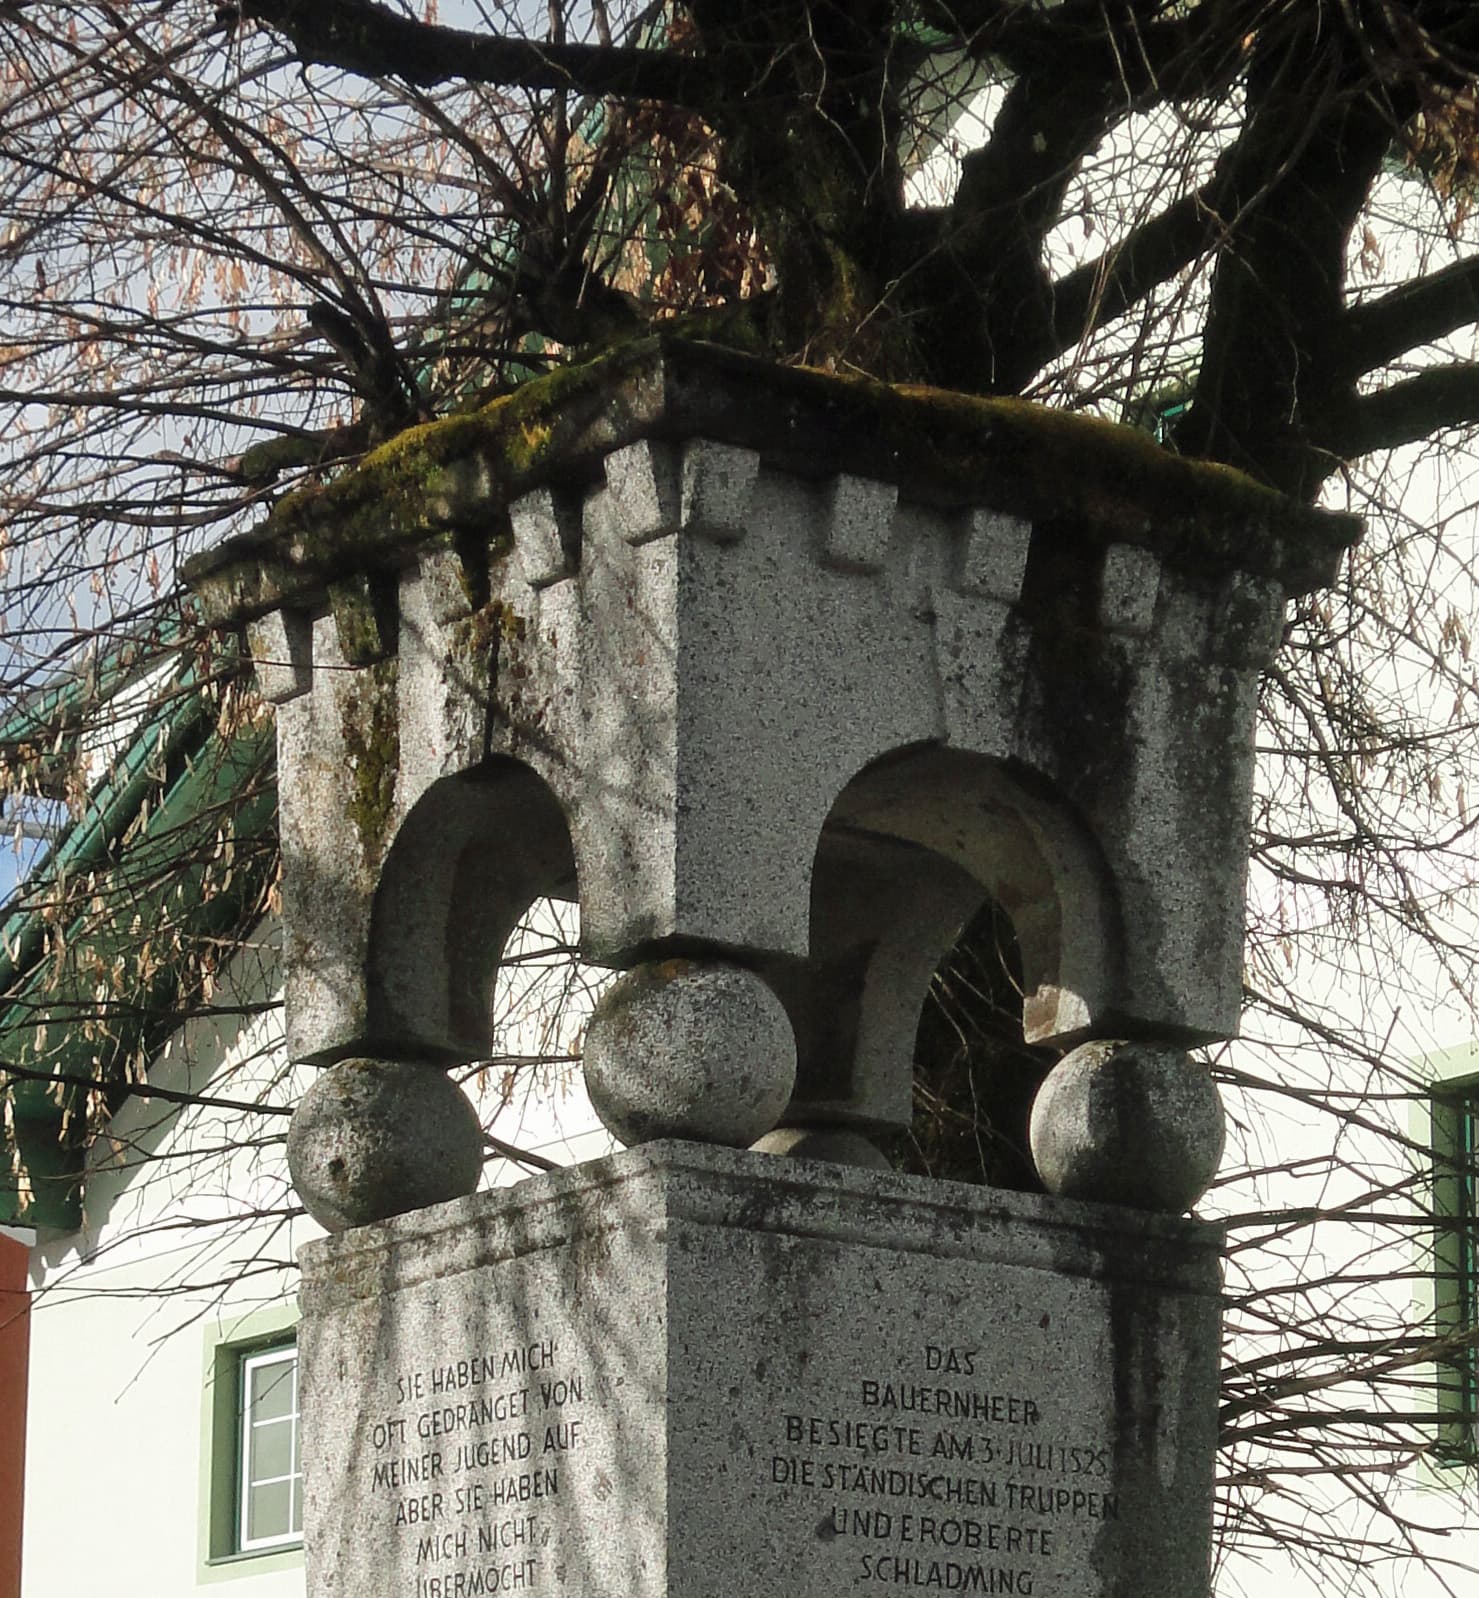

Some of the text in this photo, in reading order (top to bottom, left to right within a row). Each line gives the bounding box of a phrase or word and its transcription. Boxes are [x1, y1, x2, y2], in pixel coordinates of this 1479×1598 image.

[397, 1340, 554, 1404] SIE HABEN MICH
[924, 1345, 976, 1376] DAS
[372, 1418, 406, 1449] OFT
[540, 1376, 582, 1410] VON
[861, 1379, 1038, 1426] BAUERNHEER
[371, 1420, 581, 1492] MEINER JUGEND AUF
[784, 1414, 922, 1455] BESIEGTE
[931, 1430, 972, 1462] AM
[1005, 1440, 1052, 1471] JULI
[1058, 1446, 1108, 1477] 1525
[395, 1468, 558, 1527] ABER SIE HABEN
[771, 1456, 1119, 1521] DIE STÄNDISCHEN TRUPPEN
[416, 1515, 537, 1565] MICH NICHT
[831, 1506, 1054, 1556] UND EROBERTE
[860, 1554, 1034, 1596] SCHLADMING
